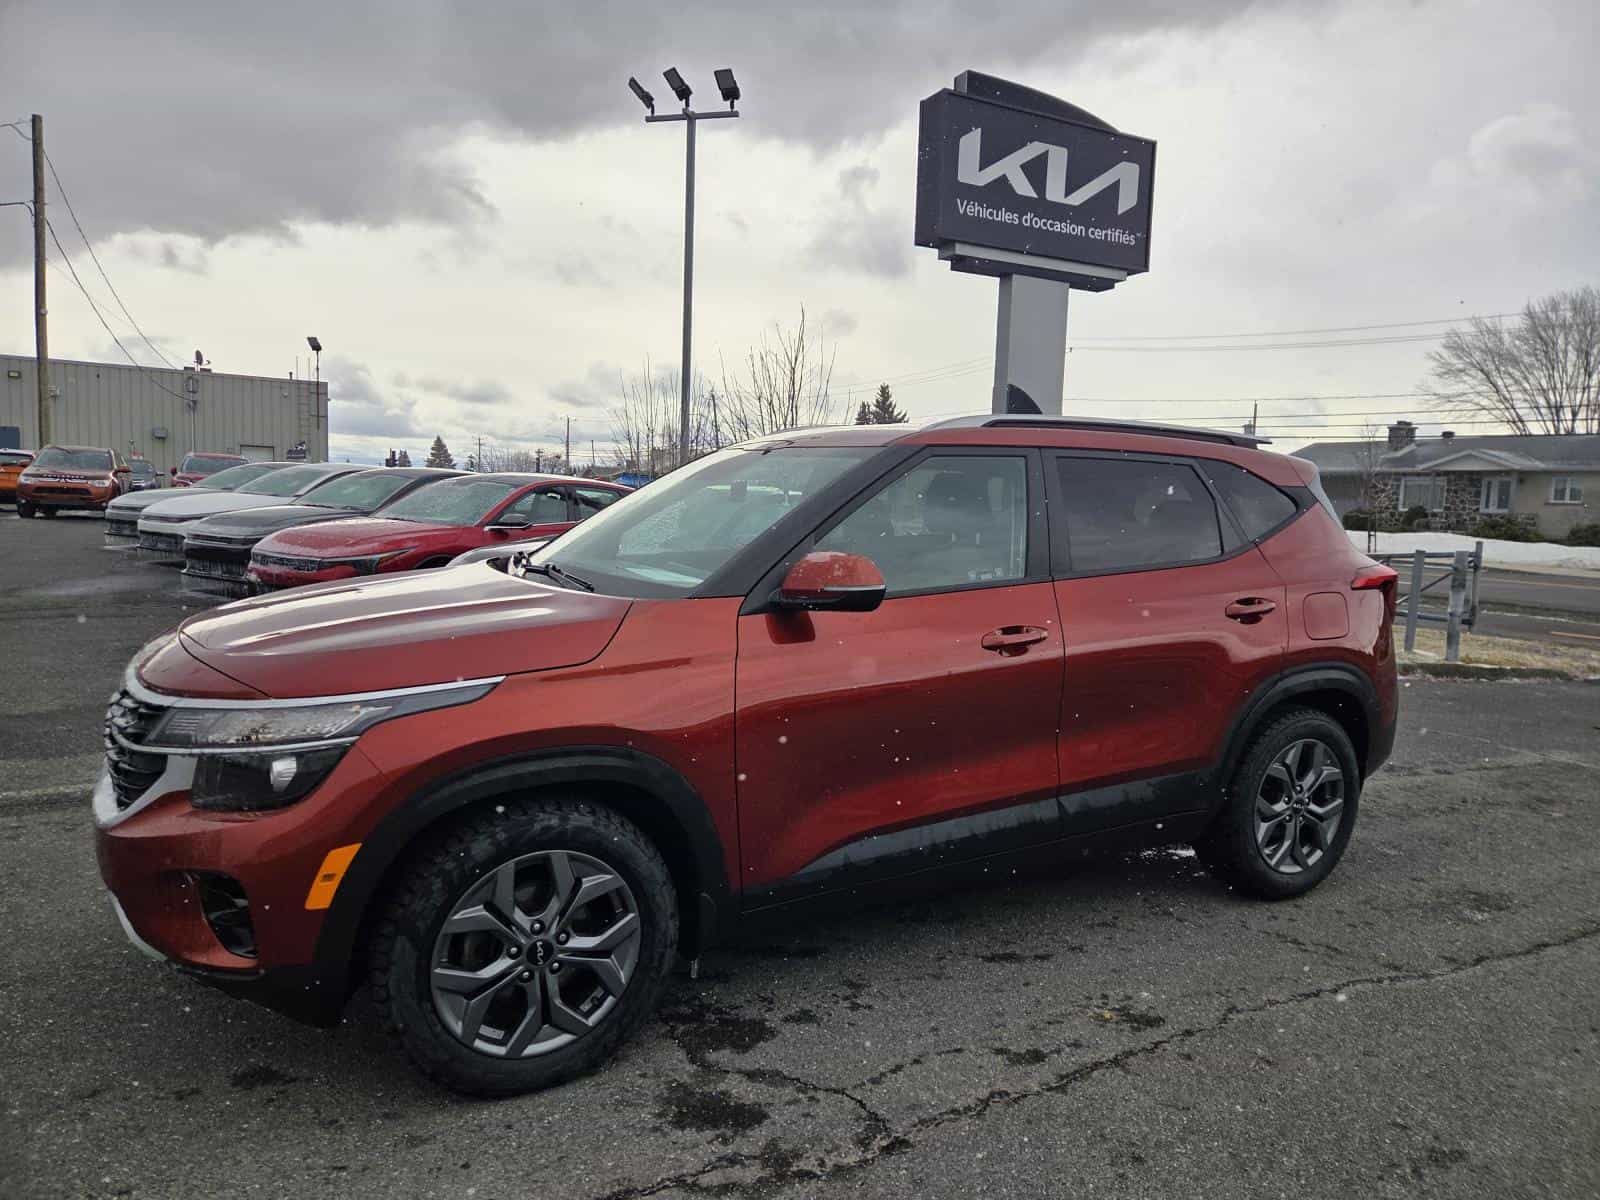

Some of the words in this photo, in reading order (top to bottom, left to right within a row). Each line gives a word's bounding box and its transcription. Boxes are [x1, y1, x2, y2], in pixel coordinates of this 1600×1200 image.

[957, 127, 1140, 216] KIA
[956, 197, 1019, 225] Véhicules
[1022, 211, 1086, 238] d'occasion
[1088, 227, 1136, 246] certifiés
